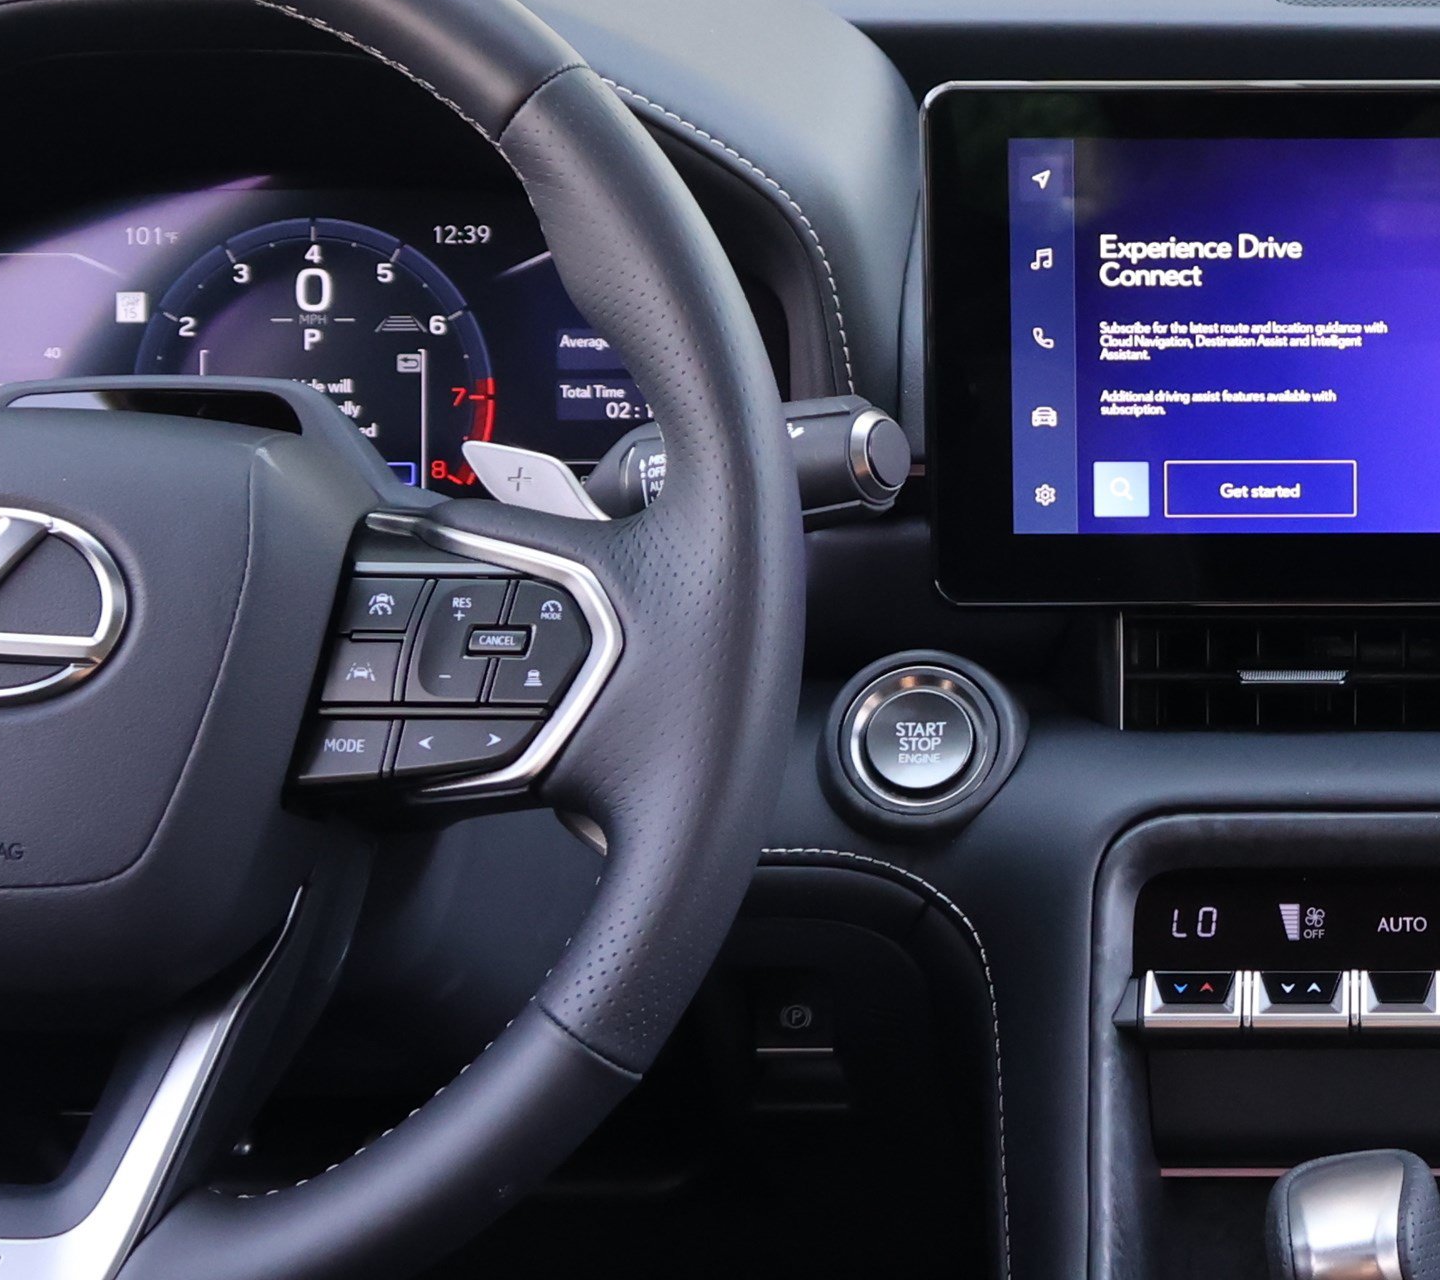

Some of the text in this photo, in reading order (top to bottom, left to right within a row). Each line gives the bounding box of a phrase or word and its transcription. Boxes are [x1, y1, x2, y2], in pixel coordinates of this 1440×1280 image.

[432, 225, 491, 244] 12:39
[304, 245, 321, 262] 4
[1099, 233, 1303, 264] Experience Drive
[233, 264, 250, 282] 3
[376, 264, 394, 282] 5
[1099, 262, 1203, 287] Connect
[296, 268, 330, 312] 0
[299, 314, 327, 324] MPH
[429, 317, 447, 335] 6
[178, 318, 196, 336] 2
[1099, 321, 1388, 337] Subscribe for the latest route and location guidance with
[304, 329, 321, 350] P
[1099, 335, 1362, 350] Cloud Navigation, Destination Assist and Intelligent
[43, 347, 62, 360] 40
[1099, 349, 1151, 361] Assistant.
[327, 378, 352, 393] will
[560, 384, 625, 399] Total Time
[451, 388, 468, 406] 7
[1100, 389, 1337, 404] Additional driving assist features available with
[1100, 404, 1166, 417] subscription.
[431, 460, 447, 479] 8
[1220, 483, 1301, 499] Get started
[452, 597, 472, 609] RES
[540, 612, 563, 621] MODE
[478, 635, 516, 646] CANCEL
[895, 722, 946, 737] START
[324, 738, 365, 753] MODE
[898, 737, 941, 752] STOP
[898, 753, 941, 763] ENGINE
[1171, 906, 1218, 938] LO
[1377, 917, 1427, 933] AUTO
[1303, 929, 1325, 940] OFF
